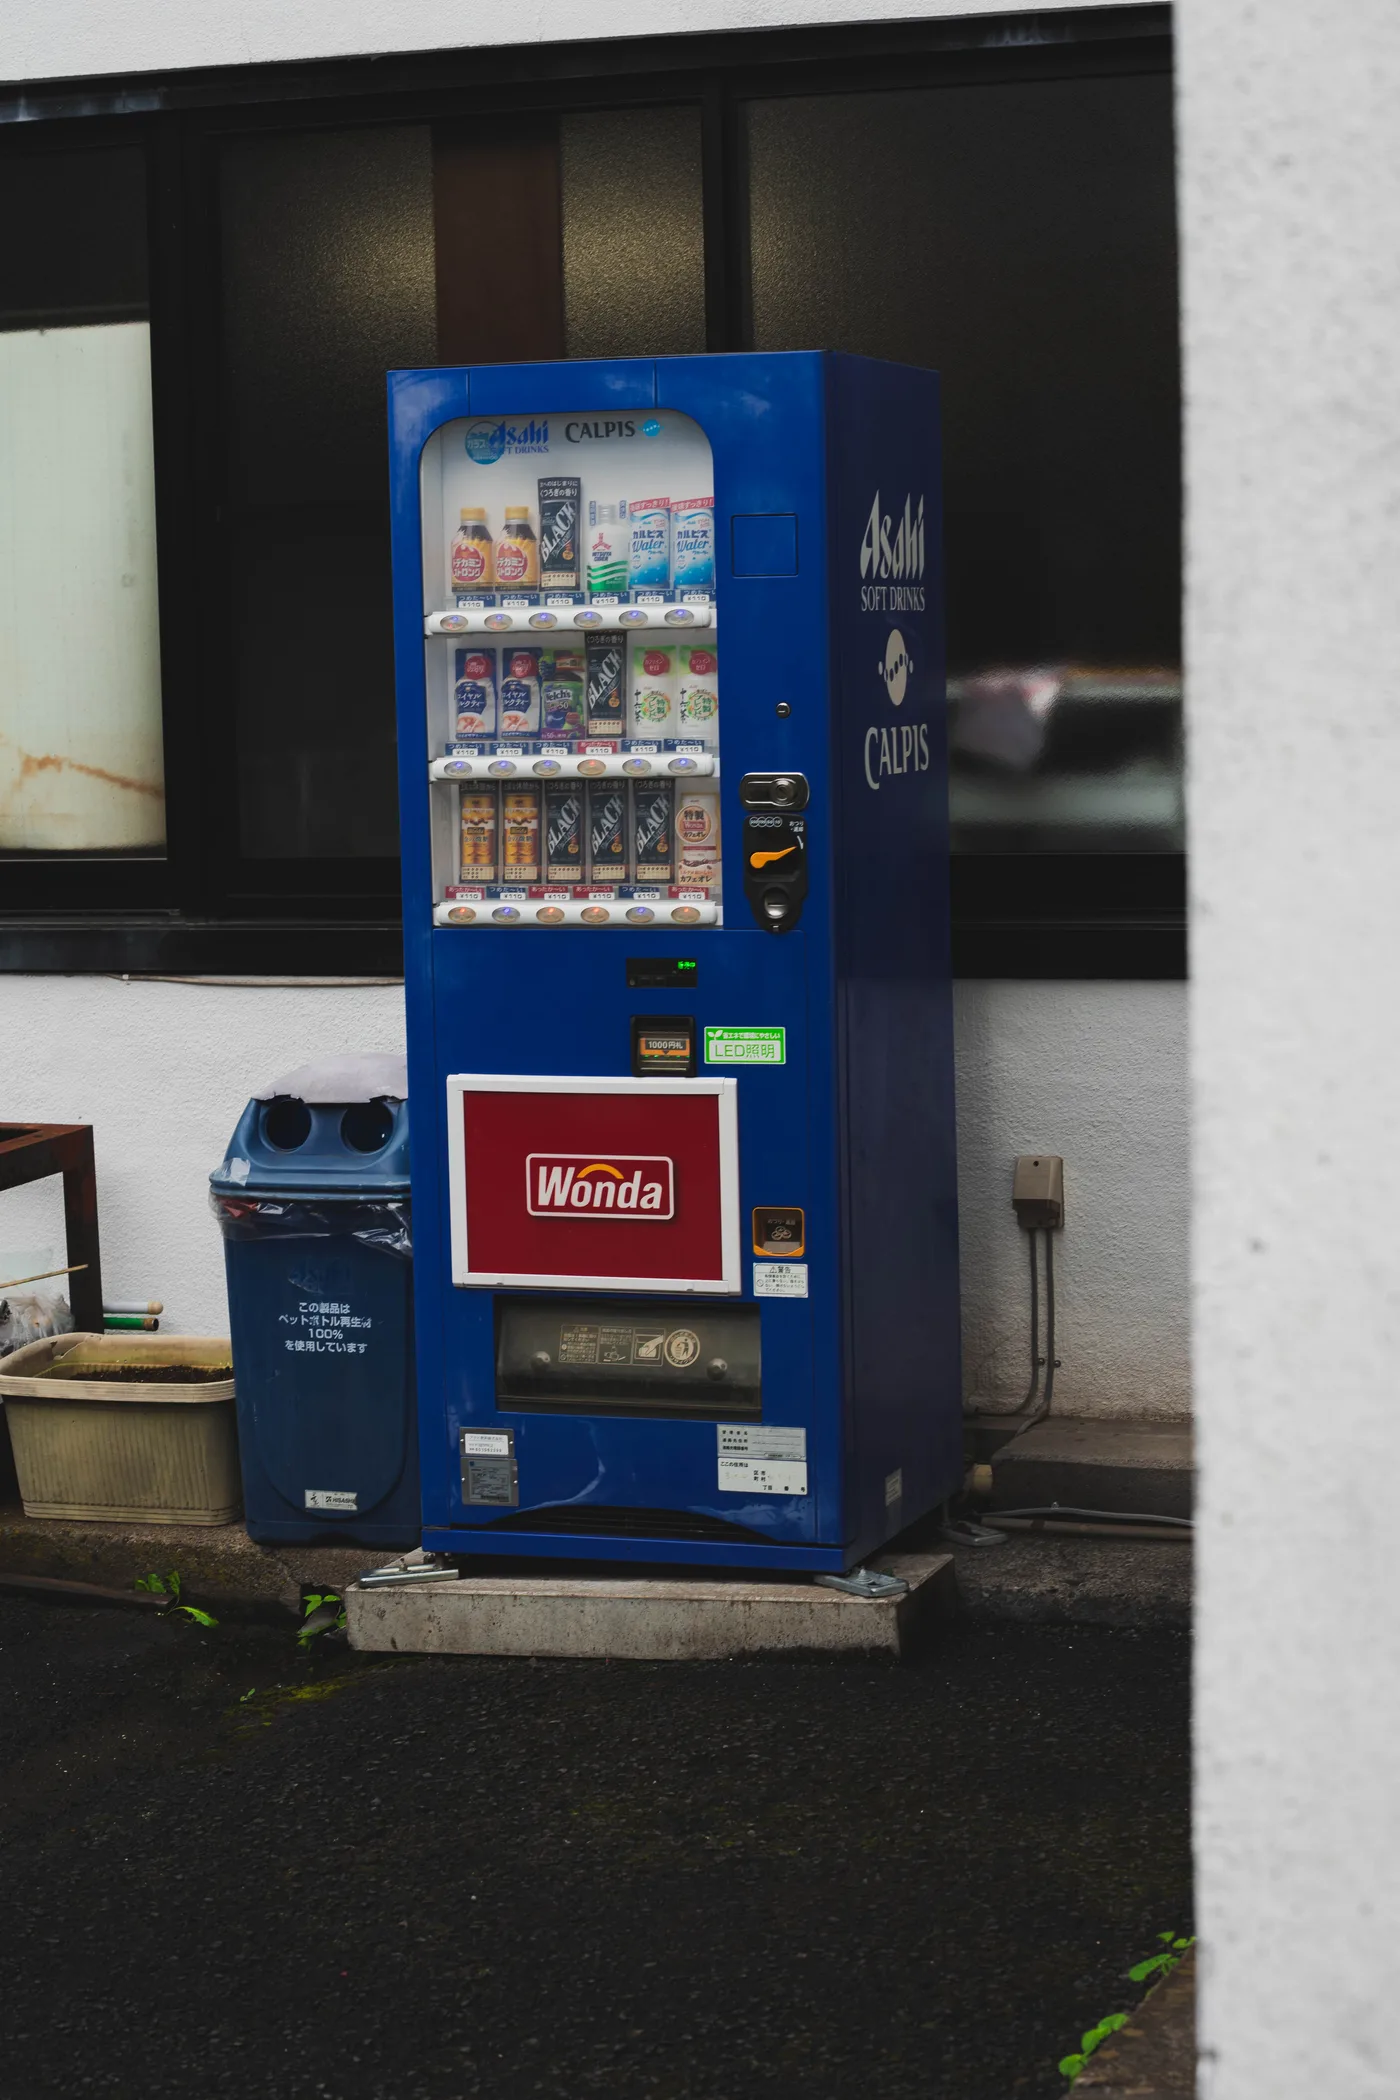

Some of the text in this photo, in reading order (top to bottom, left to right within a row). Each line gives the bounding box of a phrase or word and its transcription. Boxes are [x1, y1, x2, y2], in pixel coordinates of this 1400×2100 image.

[488, 419, 549, 446] Asahi
[565, 421, 636, 444] CALPIS
[515, 445, 549, 454] DRINKS
[859, 488, 925, 581] Asahi
[632, 539, 664, 552] Water
[677, 539, 709, 552] Water
[861, 585, 926, 611] SOFT DRINKS
[864, 723, 930, 790] CALPIS
[683, 810, 704, 820] 特製
[648, 1040, 683, 1050] 1000円札
[715, 1043, 775, 1059] LED照明
[537, 1165, 663, 1209] Wonda
[298, 1302, 350, 1314] この製品は
[308, 1328, 344, 1340] 100%
[284, 1340, 368, 1354] を使用しています
